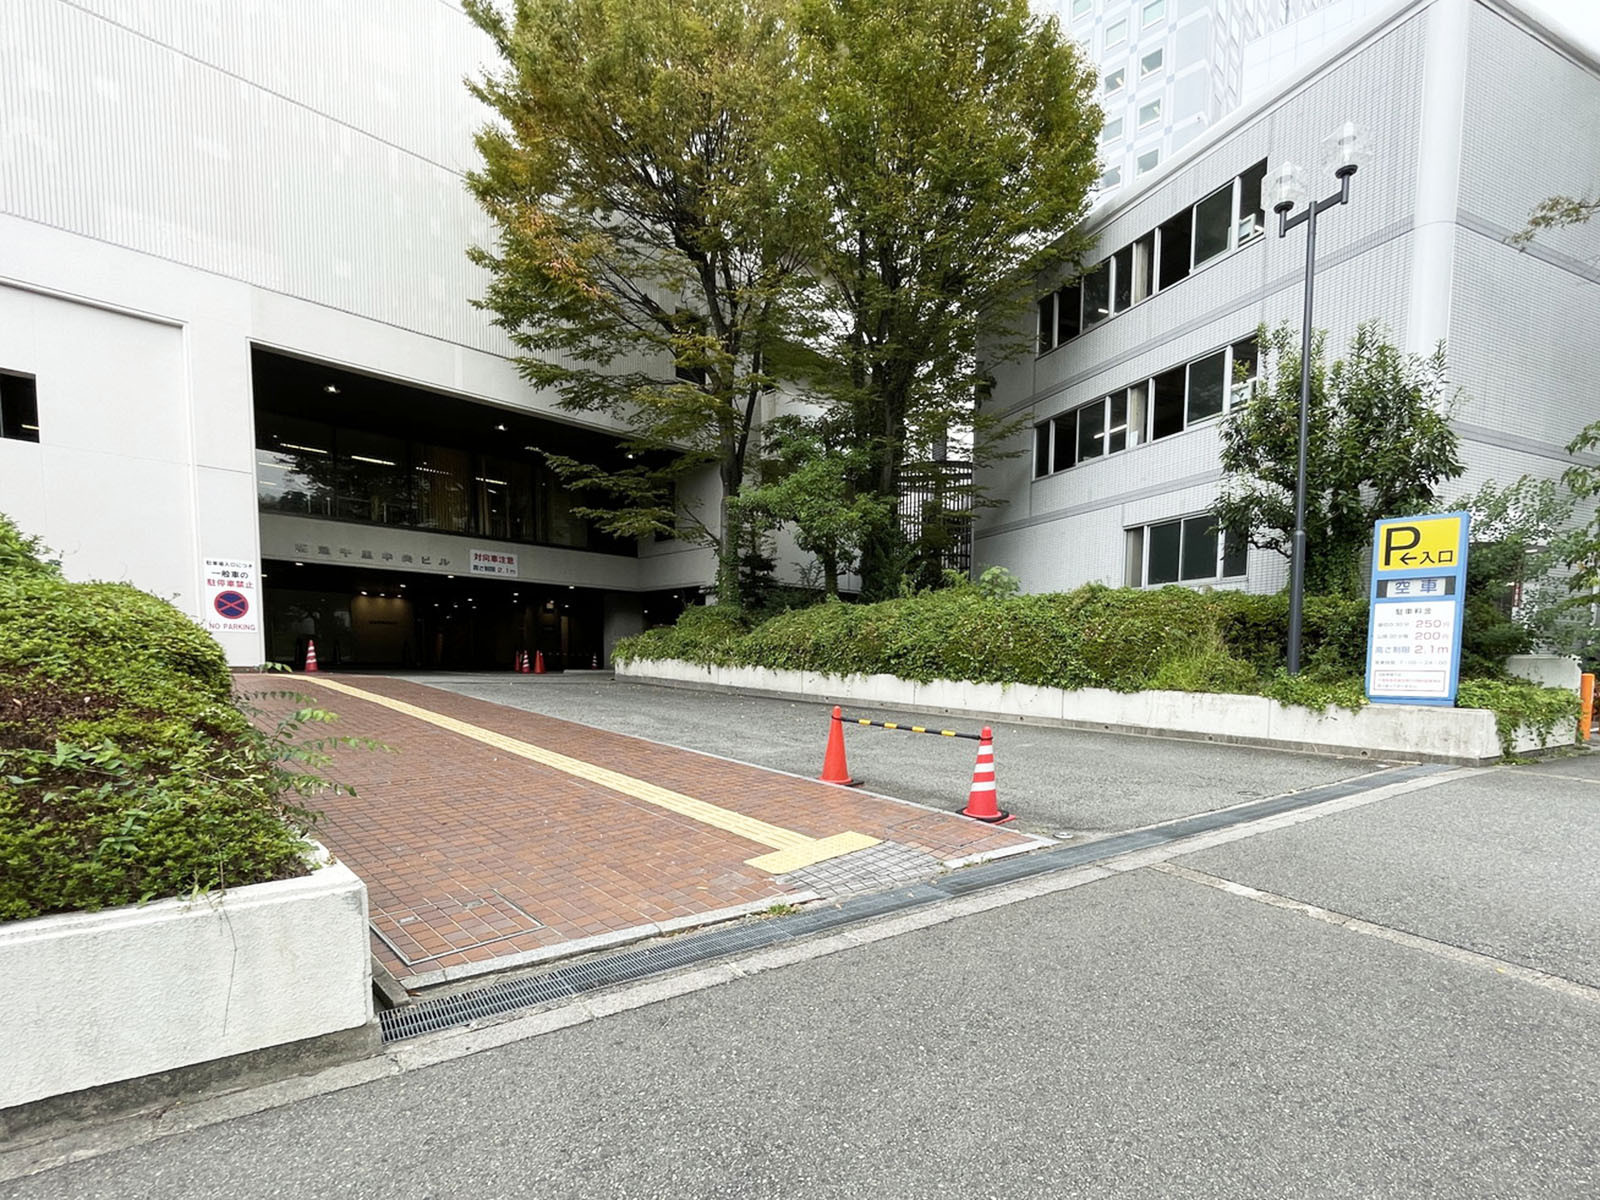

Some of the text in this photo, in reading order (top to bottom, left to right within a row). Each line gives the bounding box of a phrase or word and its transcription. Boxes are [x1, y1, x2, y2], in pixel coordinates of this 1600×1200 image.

[1384, 526, 1421, 566] P
[1420, 550, 1454, 565] 入口
[209, 621, 256, 631] NO PARKING
